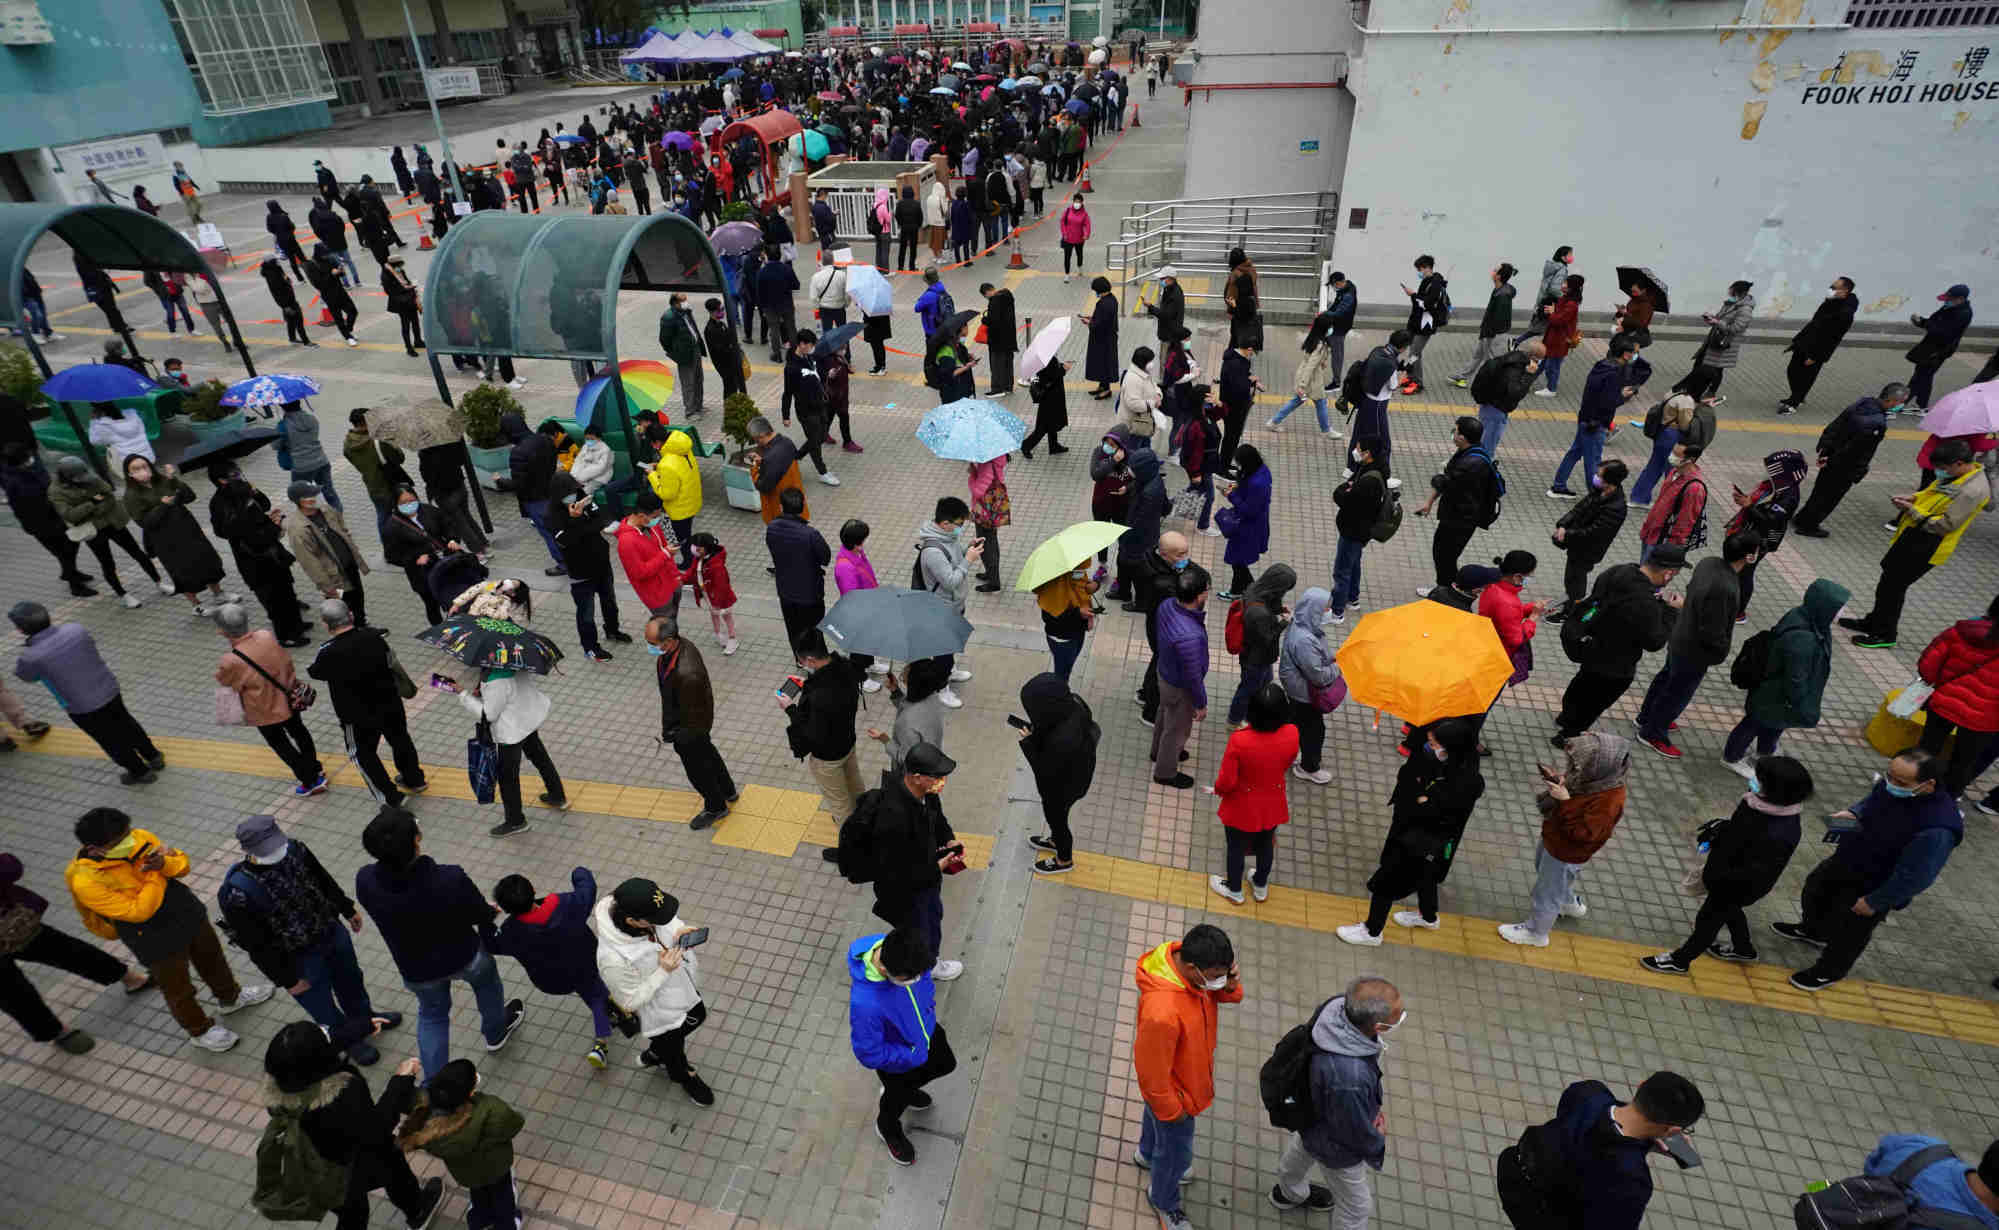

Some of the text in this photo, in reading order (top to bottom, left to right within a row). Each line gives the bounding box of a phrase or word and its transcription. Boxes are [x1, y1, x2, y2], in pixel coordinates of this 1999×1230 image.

[1801, 81, 1999, 104] FOOK HOI HOUSE
